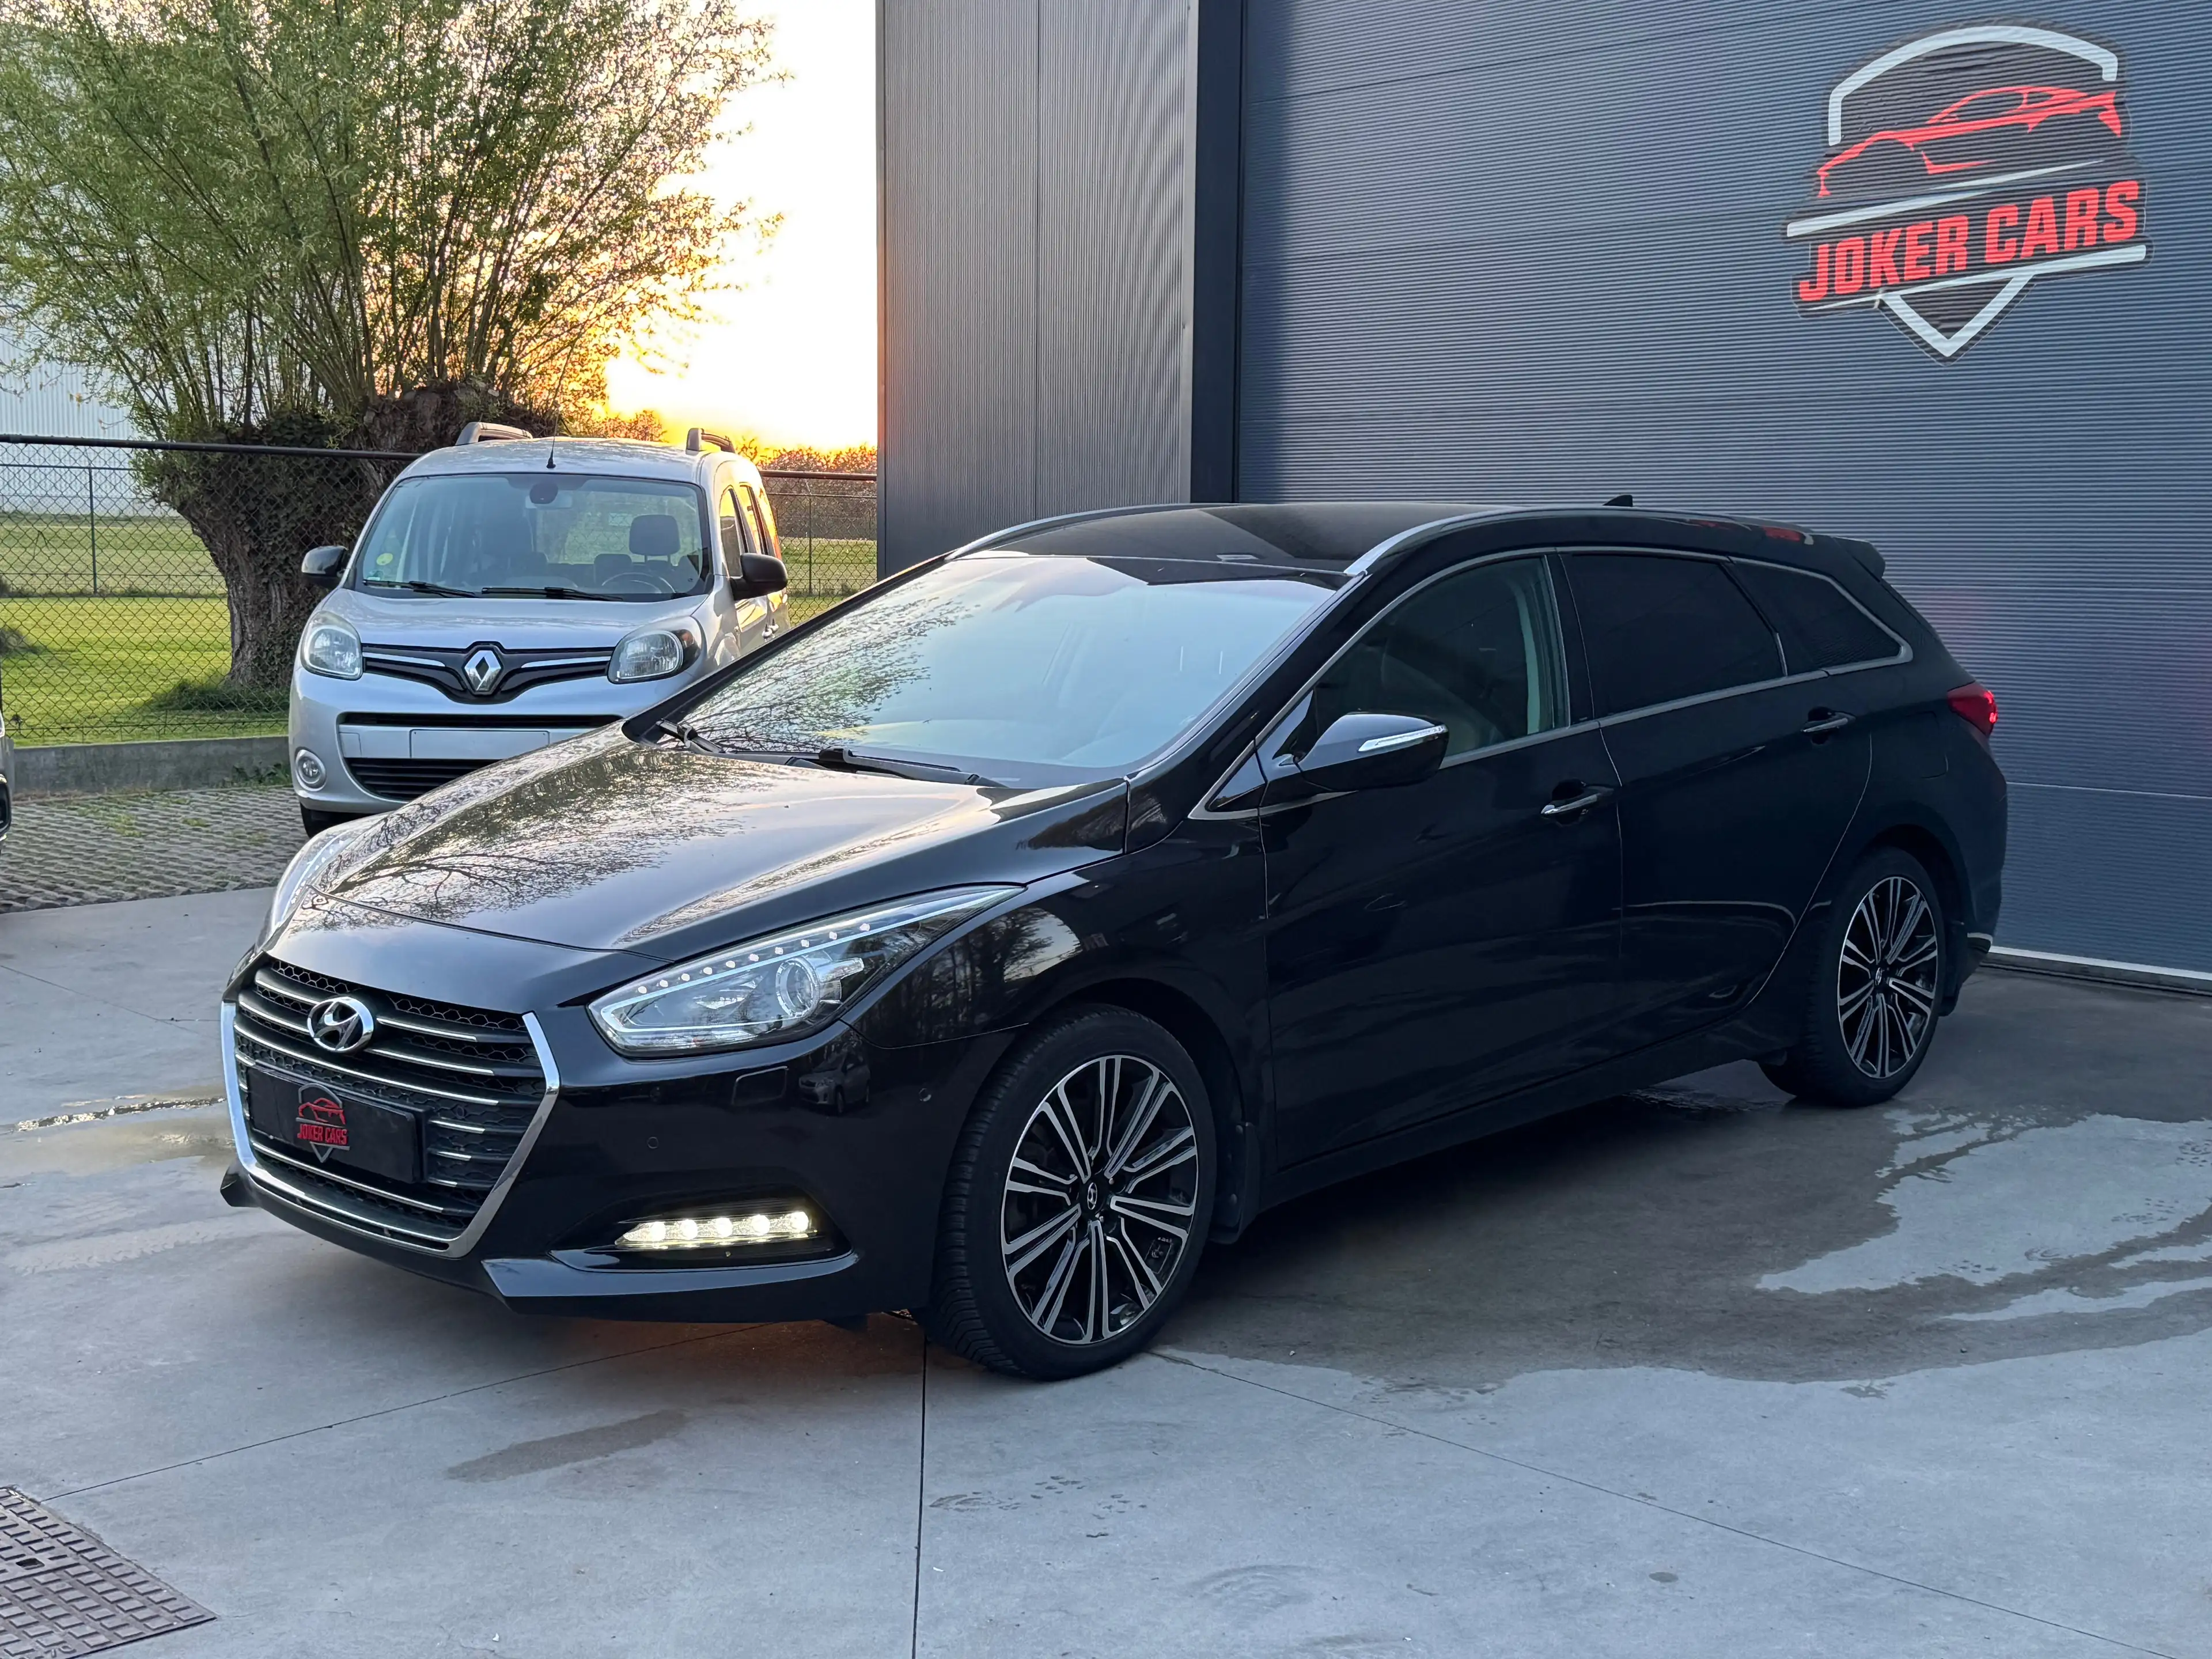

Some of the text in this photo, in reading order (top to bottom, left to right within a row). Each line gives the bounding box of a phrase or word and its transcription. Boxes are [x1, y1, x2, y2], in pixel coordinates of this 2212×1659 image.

[1798, 180, 2140, 302] JOKER CARS
[297, 1123, 347, 1145] JOKER CARS
